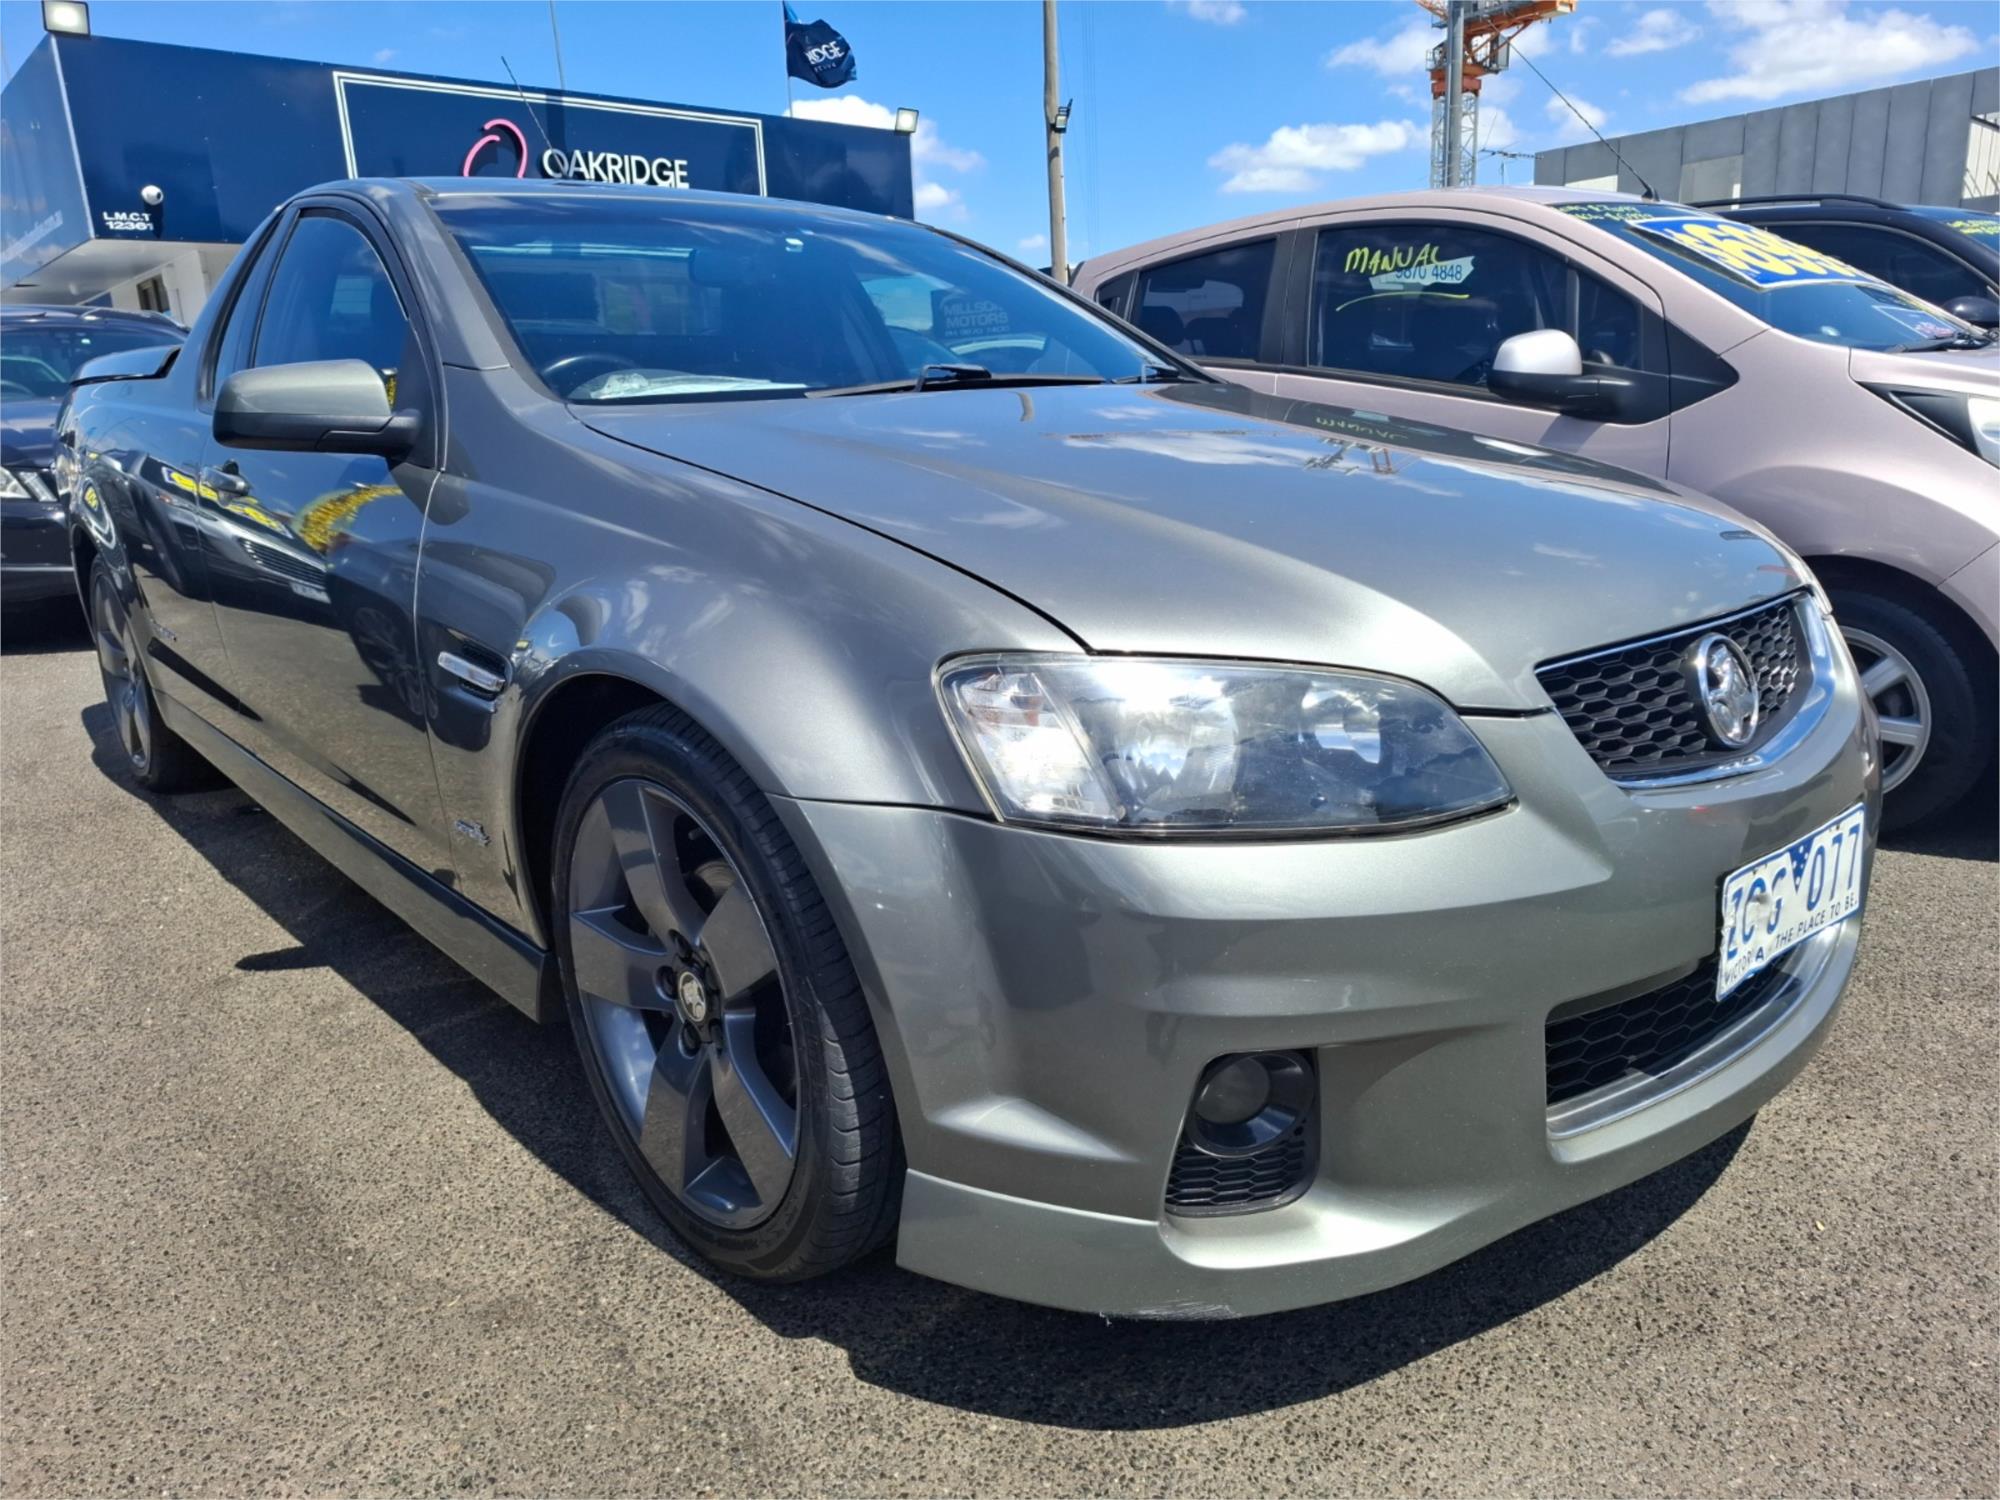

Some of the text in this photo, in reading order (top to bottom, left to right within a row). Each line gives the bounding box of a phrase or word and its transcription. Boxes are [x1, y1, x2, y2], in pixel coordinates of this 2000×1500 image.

[542, 148, 690, 189] OAKRIDGE
[105, 221, 154, 230] 12361
[1344, 243, 1442, 275] MANUAL
[1431, 264, 1463, 281] 4848
[945, 311, 1009, 329] MOTORS
[1806, 823, 1861, 911] 077
[1724, 947, 1765, 984] VICTORA
[1775, 928, 1793, 948] THE
[1797, 910, 1826, 935] PLACE
[1830, 902, 1842, 918] TO
